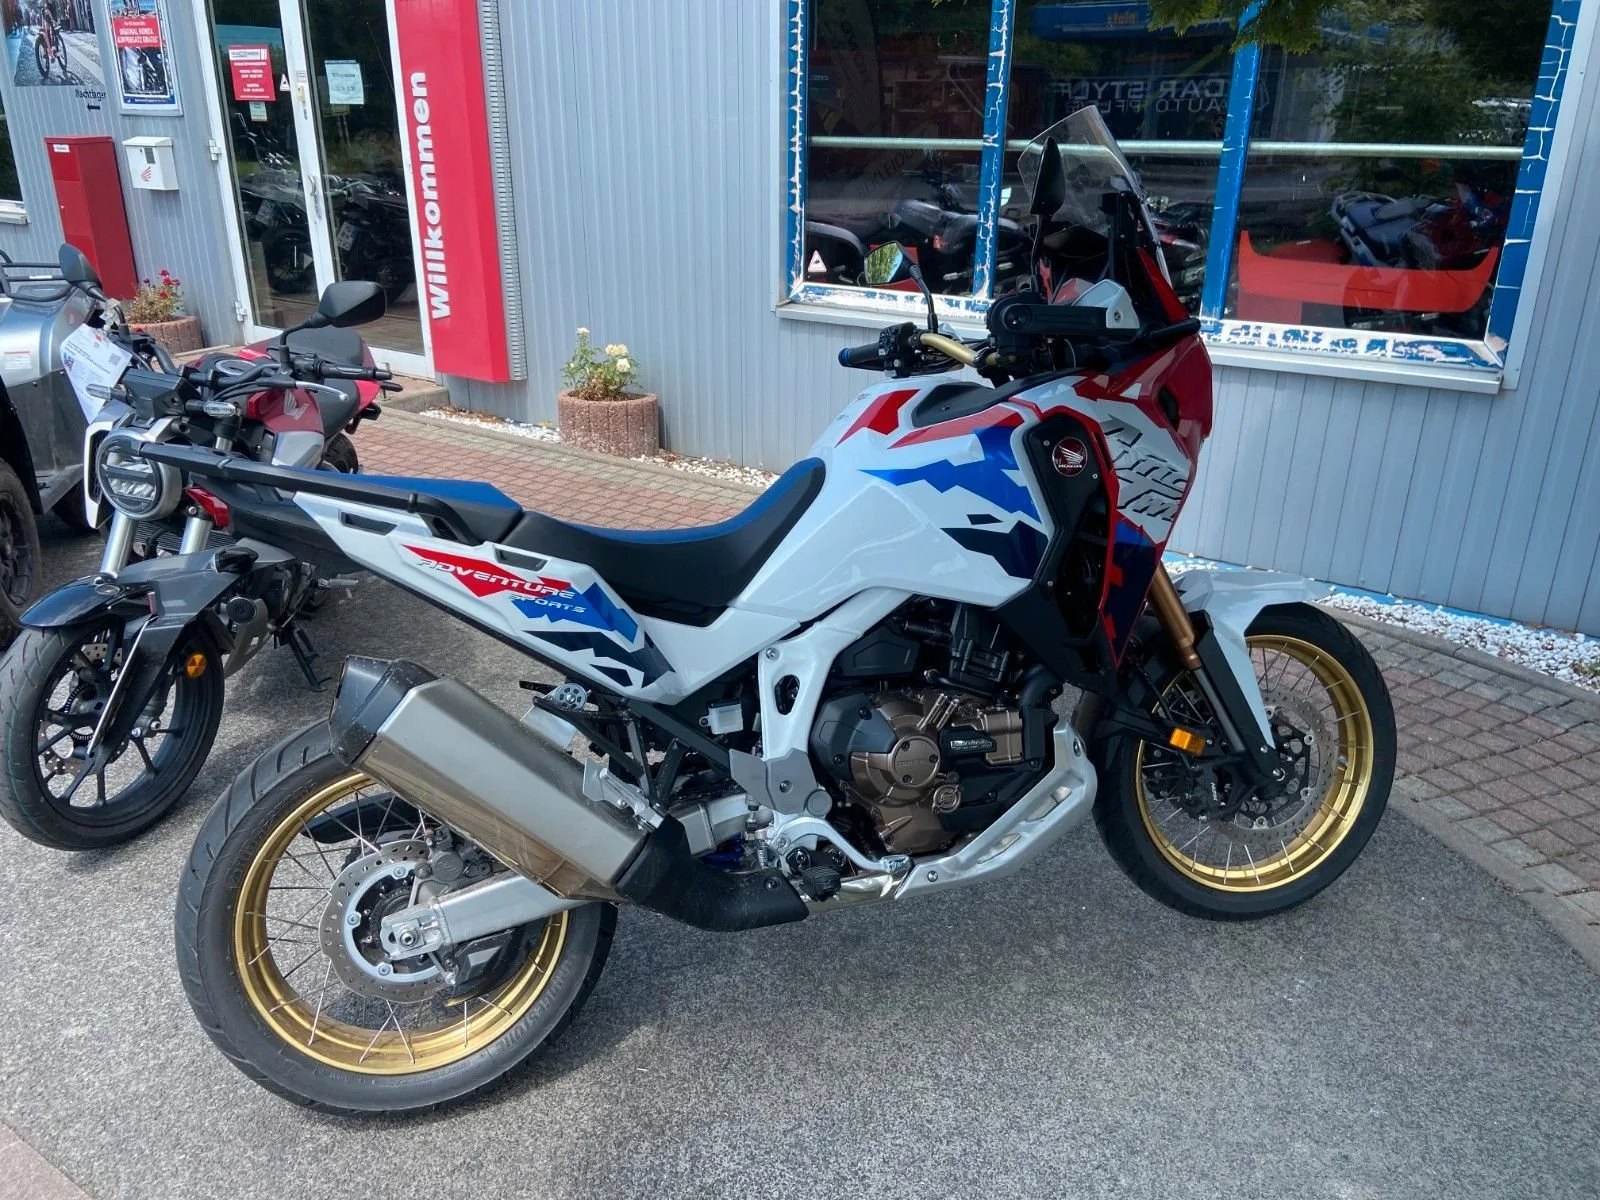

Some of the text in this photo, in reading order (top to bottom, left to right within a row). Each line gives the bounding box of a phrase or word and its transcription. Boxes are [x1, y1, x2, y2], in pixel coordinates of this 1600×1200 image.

[410, 71, 451, 320] Willkommen
[417, 558, 575, 599] ADVENTURE
[509, 594, 587, 613] SPORTS
